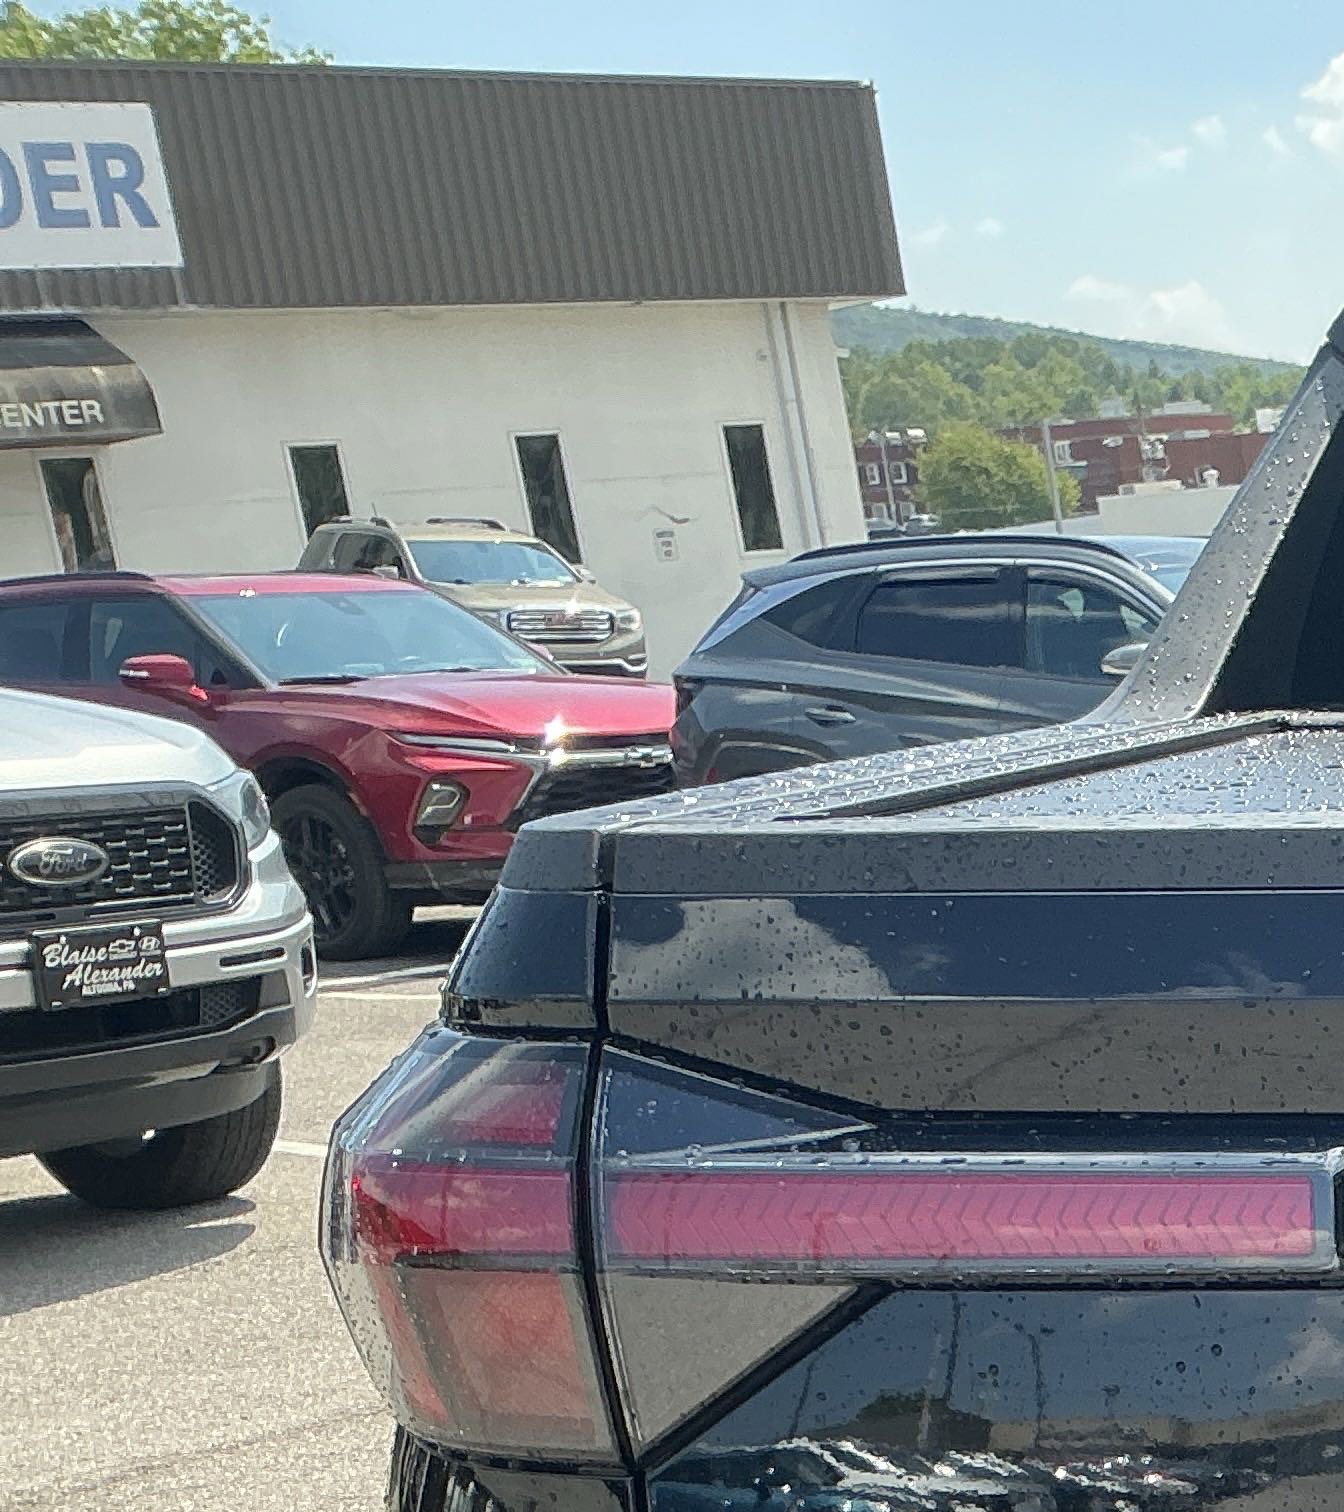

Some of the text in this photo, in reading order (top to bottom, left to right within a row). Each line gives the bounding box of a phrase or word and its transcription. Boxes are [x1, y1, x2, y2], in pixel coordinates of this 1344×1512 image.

[0, 399, 104, 428] ENTER
[38, 848, 88, 875] Ford
[42, 942, 108, 968] Blaise
[62, 957, 164, 990] Alexander
